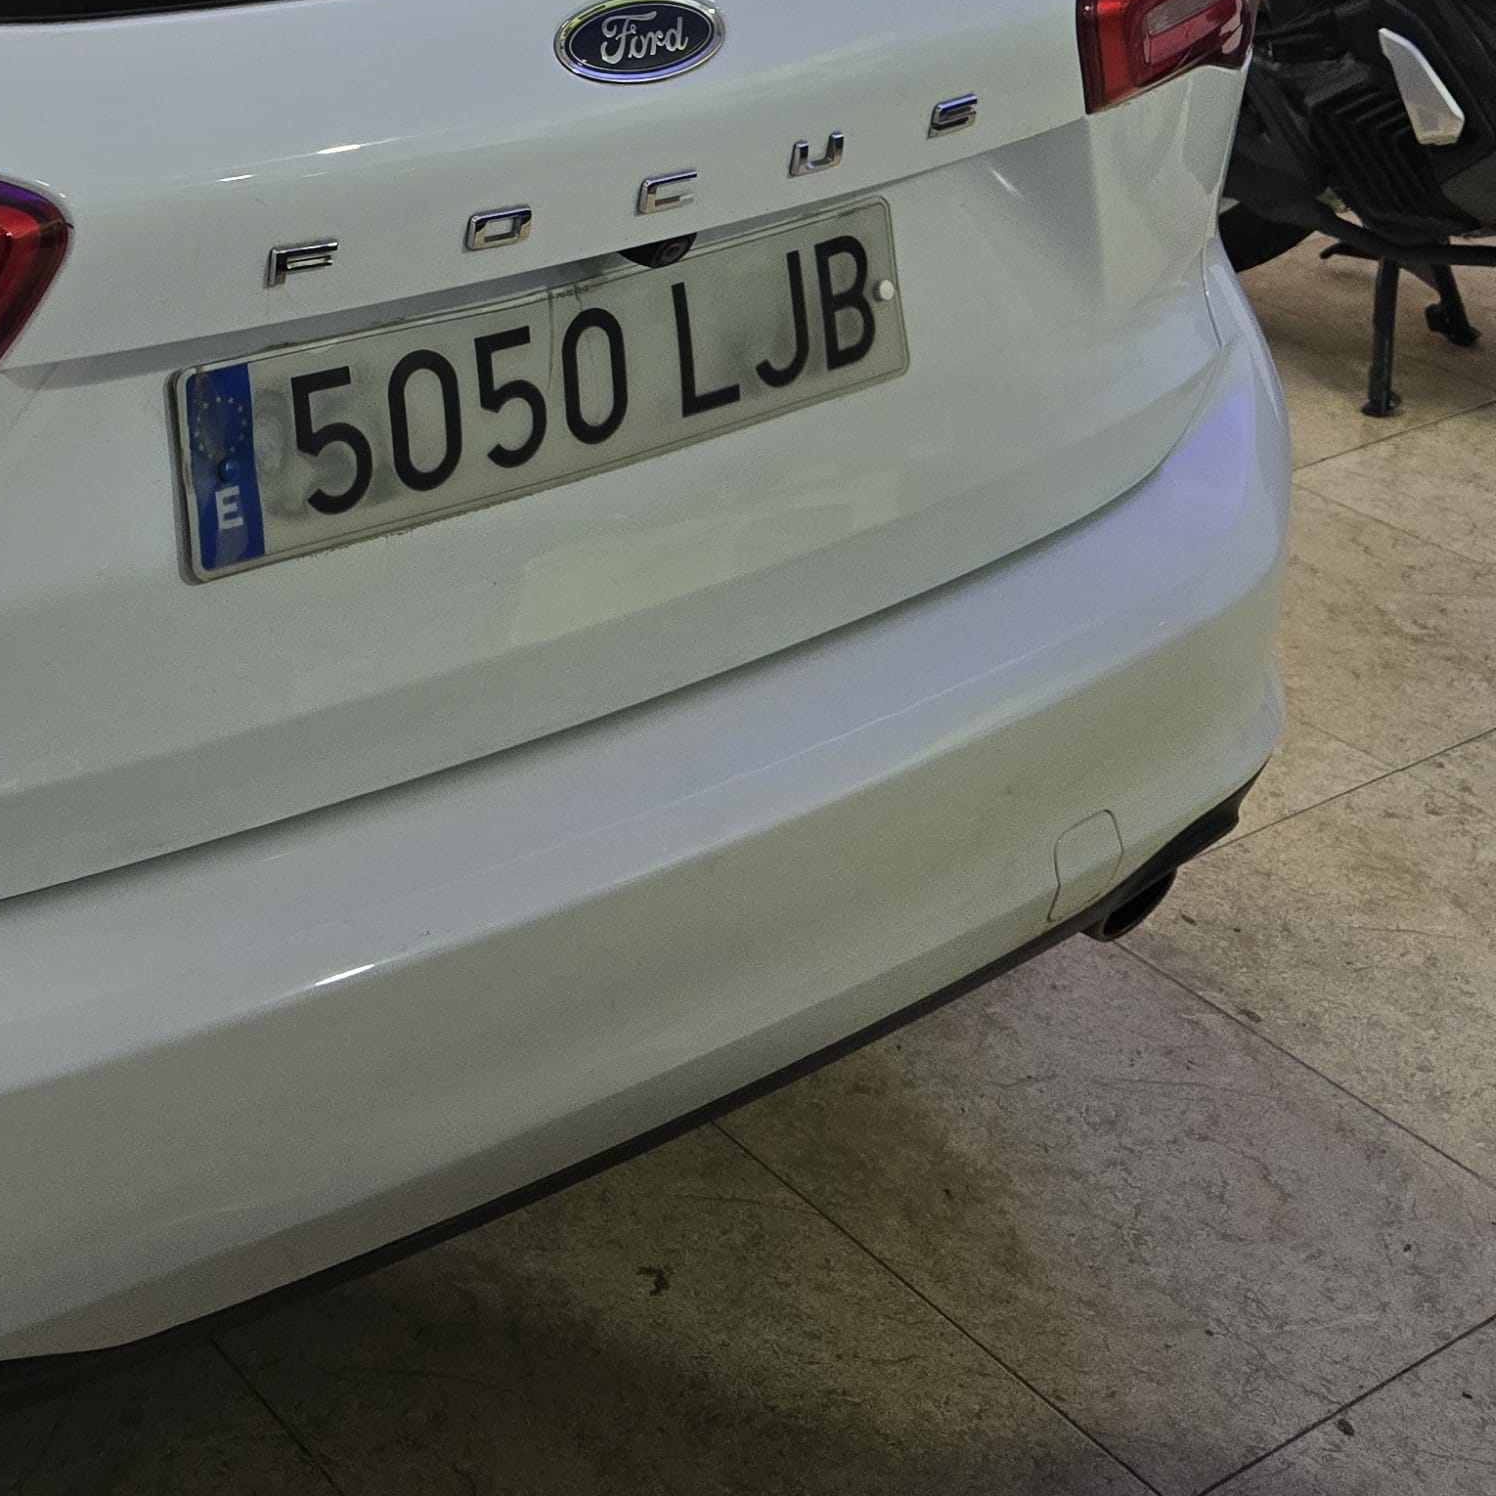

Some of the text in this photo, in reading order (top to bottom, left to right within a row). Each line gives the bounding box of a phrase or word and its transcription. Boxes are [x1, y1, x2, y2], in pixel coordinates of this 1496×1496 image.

[600, 10, 689, 65] Ford
[266, 93, 978, 288] FOCUS
[291, 234, 879, 516] 5050 LJB
[215, 485, 245, 531] E
